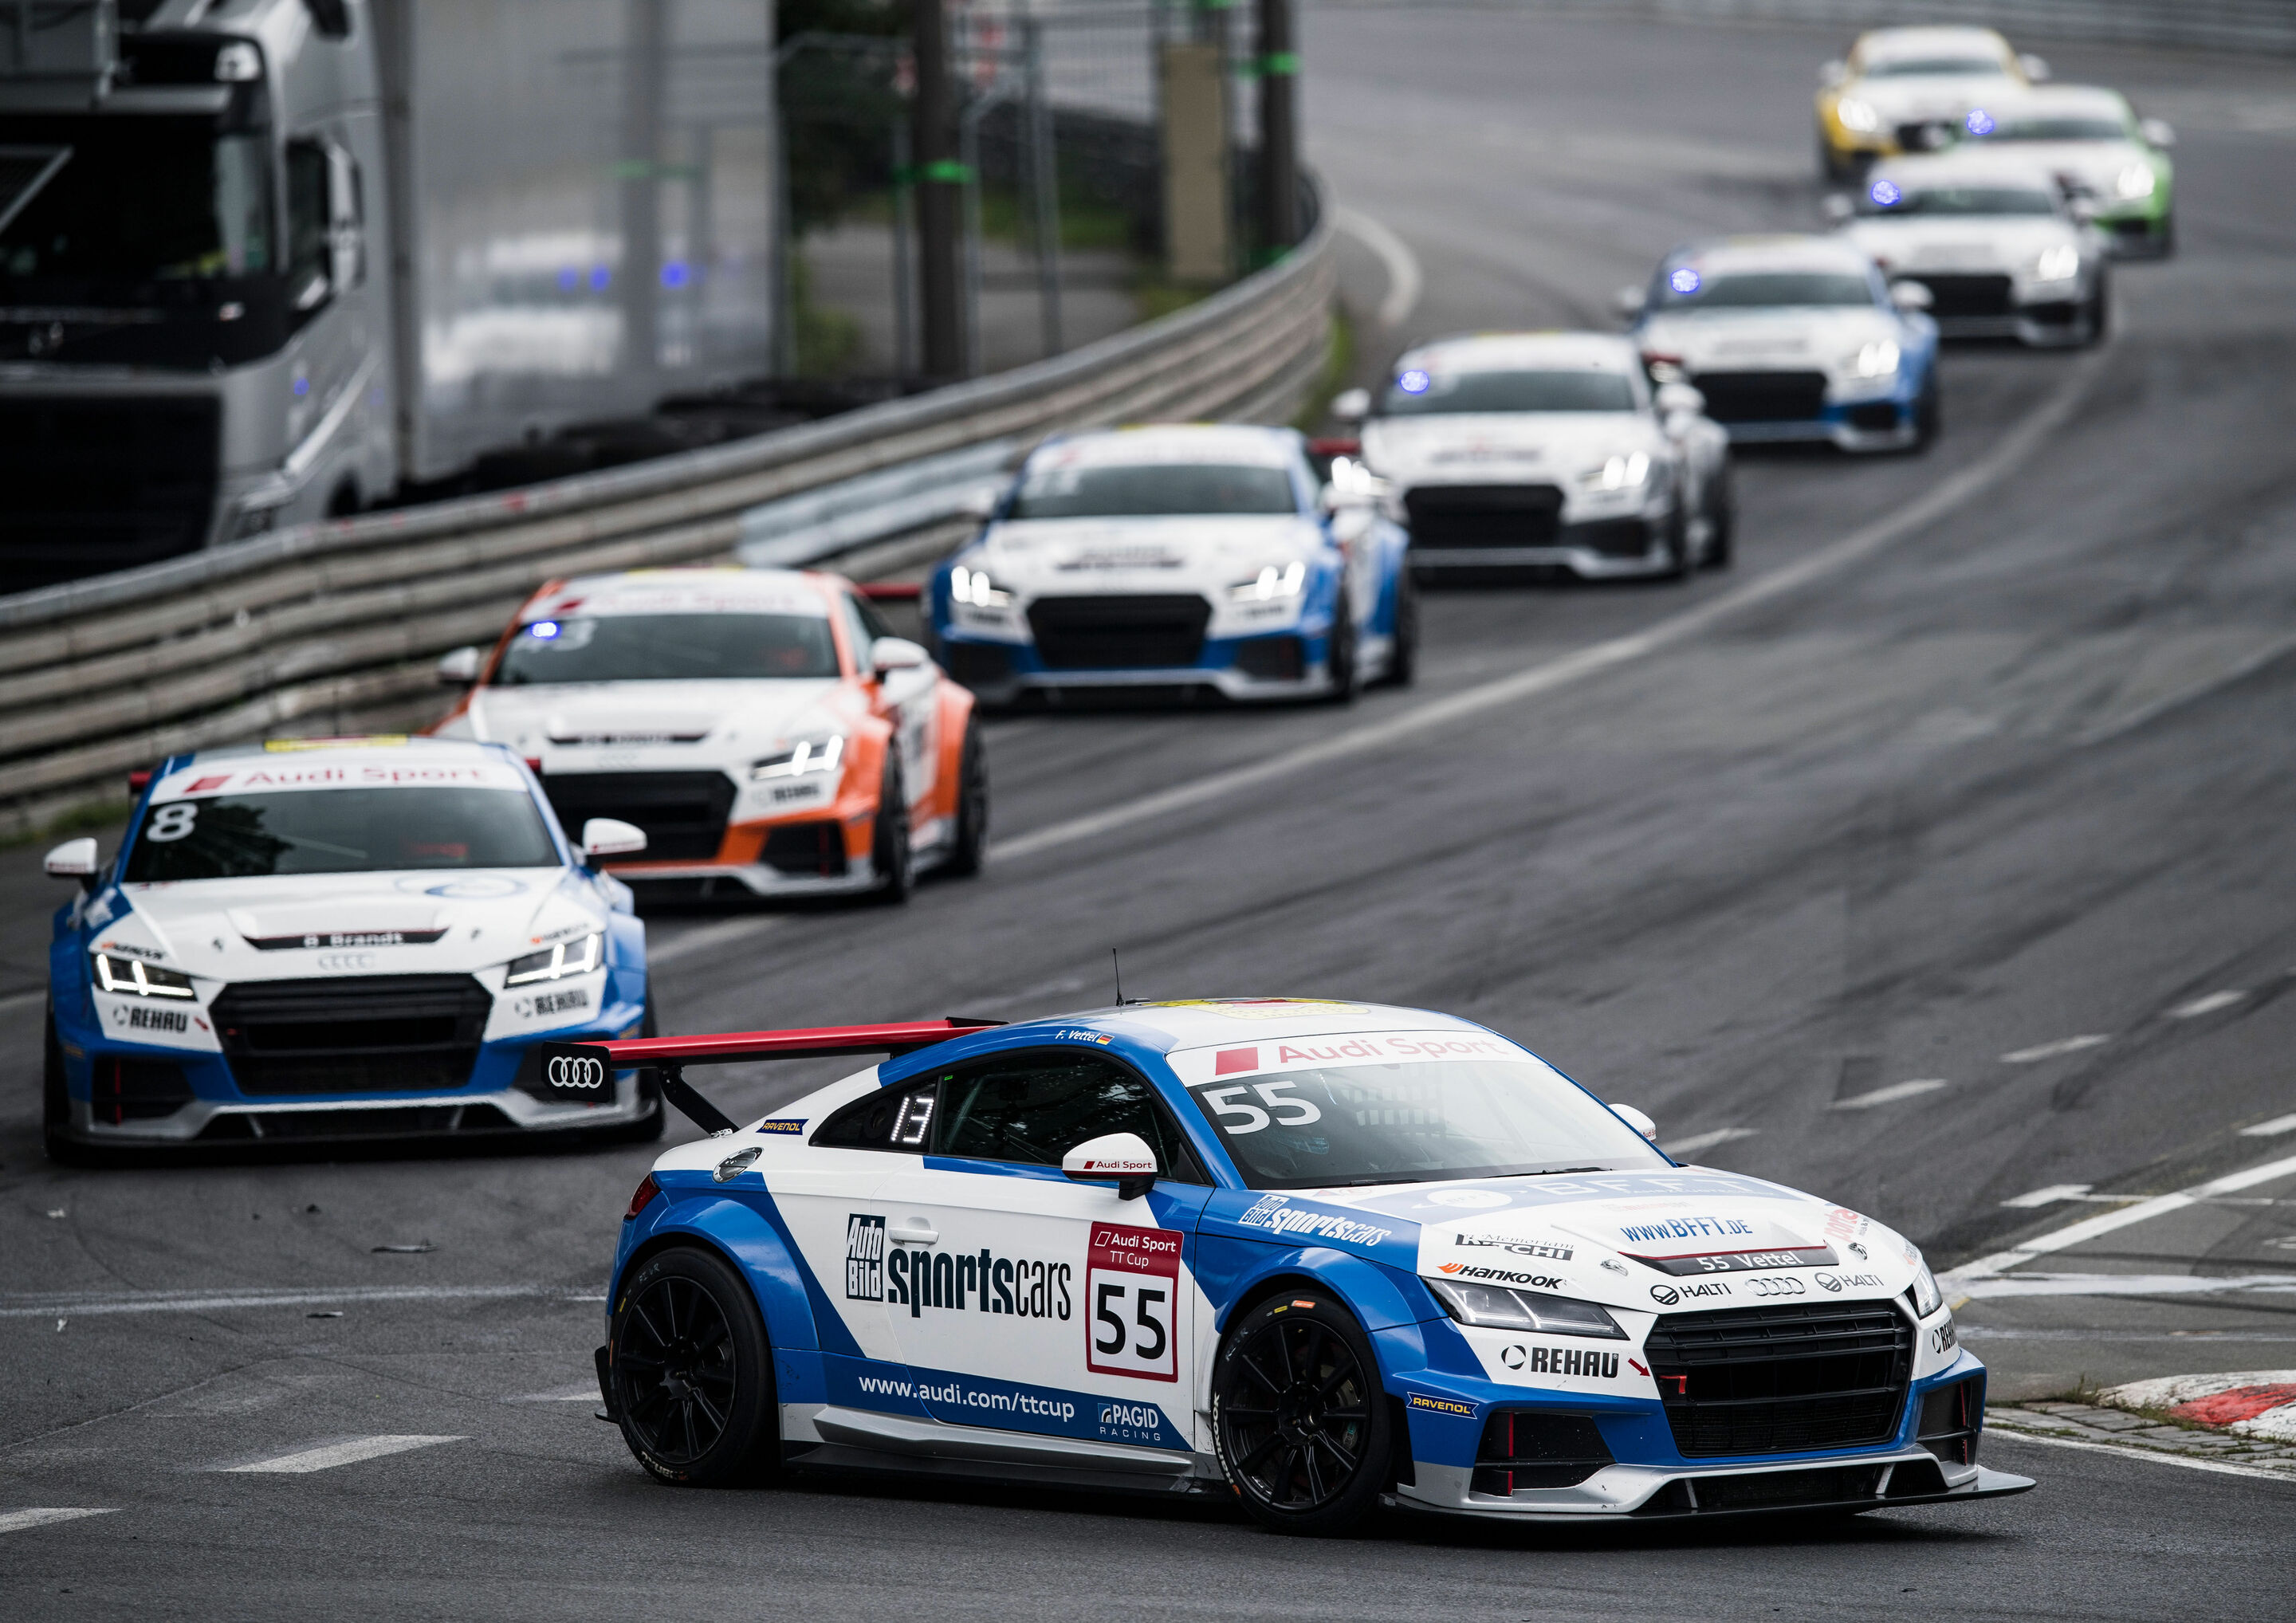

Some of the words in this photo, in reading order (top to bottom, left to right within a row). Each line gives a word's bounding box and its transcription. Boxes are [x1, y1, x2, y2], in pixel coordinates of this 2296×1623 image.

[513, 618, 596, 652] 3
[244, 768, 344, 786] Audi
[363, 766, 485, 784] Sport
[147, 803, 199, 842] 8
[130, 1005, 188, 1032] REHAU
[1067, 1030, 1099, 1043] Vettel
[1280, 1039, 1384, 1064] Audi
[1394, 1037, 1508, 1059] Sport
[890, 1096, 934, 1142] 13
[1201, 1080, 1321, 1134] 55
[762, 1122, 801, 1131] RAVENOL
[1122, 1161, 1152, 1170] Sport
[847, 1217, 884, 1260] Auto
[1264, 1208, 1392, 1247] sportscars
[1111, 1233, 1139, 1248] Audi
[1142, 1236, 1177, 1252] Sport
[1110, 1251, 1125, 1263] TT
[1126, 1252, 1149, 1267] Cup
[1696, 1256, 1723, 1271] 55
[1736, 1250, 1804, 1268] Vettel
[847, 1260, 882, 1299] Bild
[888, 1248, 1071, 1321] sportscars
[1680, 1283, 1732, 1299] HALTI
[1839, 1275, 1884, 1287] HALTI
[1095, 1283, 1166, 1360] 55
[1940, 1319, 1956, 1352] REH
[1531, 1347, 1619, 1378] REHAU
[859, 1377, 1075, 1422] www.audi.com/ttcup
[1413, 1397, 1472, 1415] RAVENOL
[1112, 1404, 1158, 1428] PAGID
[1099, 1427, 1161, 1441] RACING
